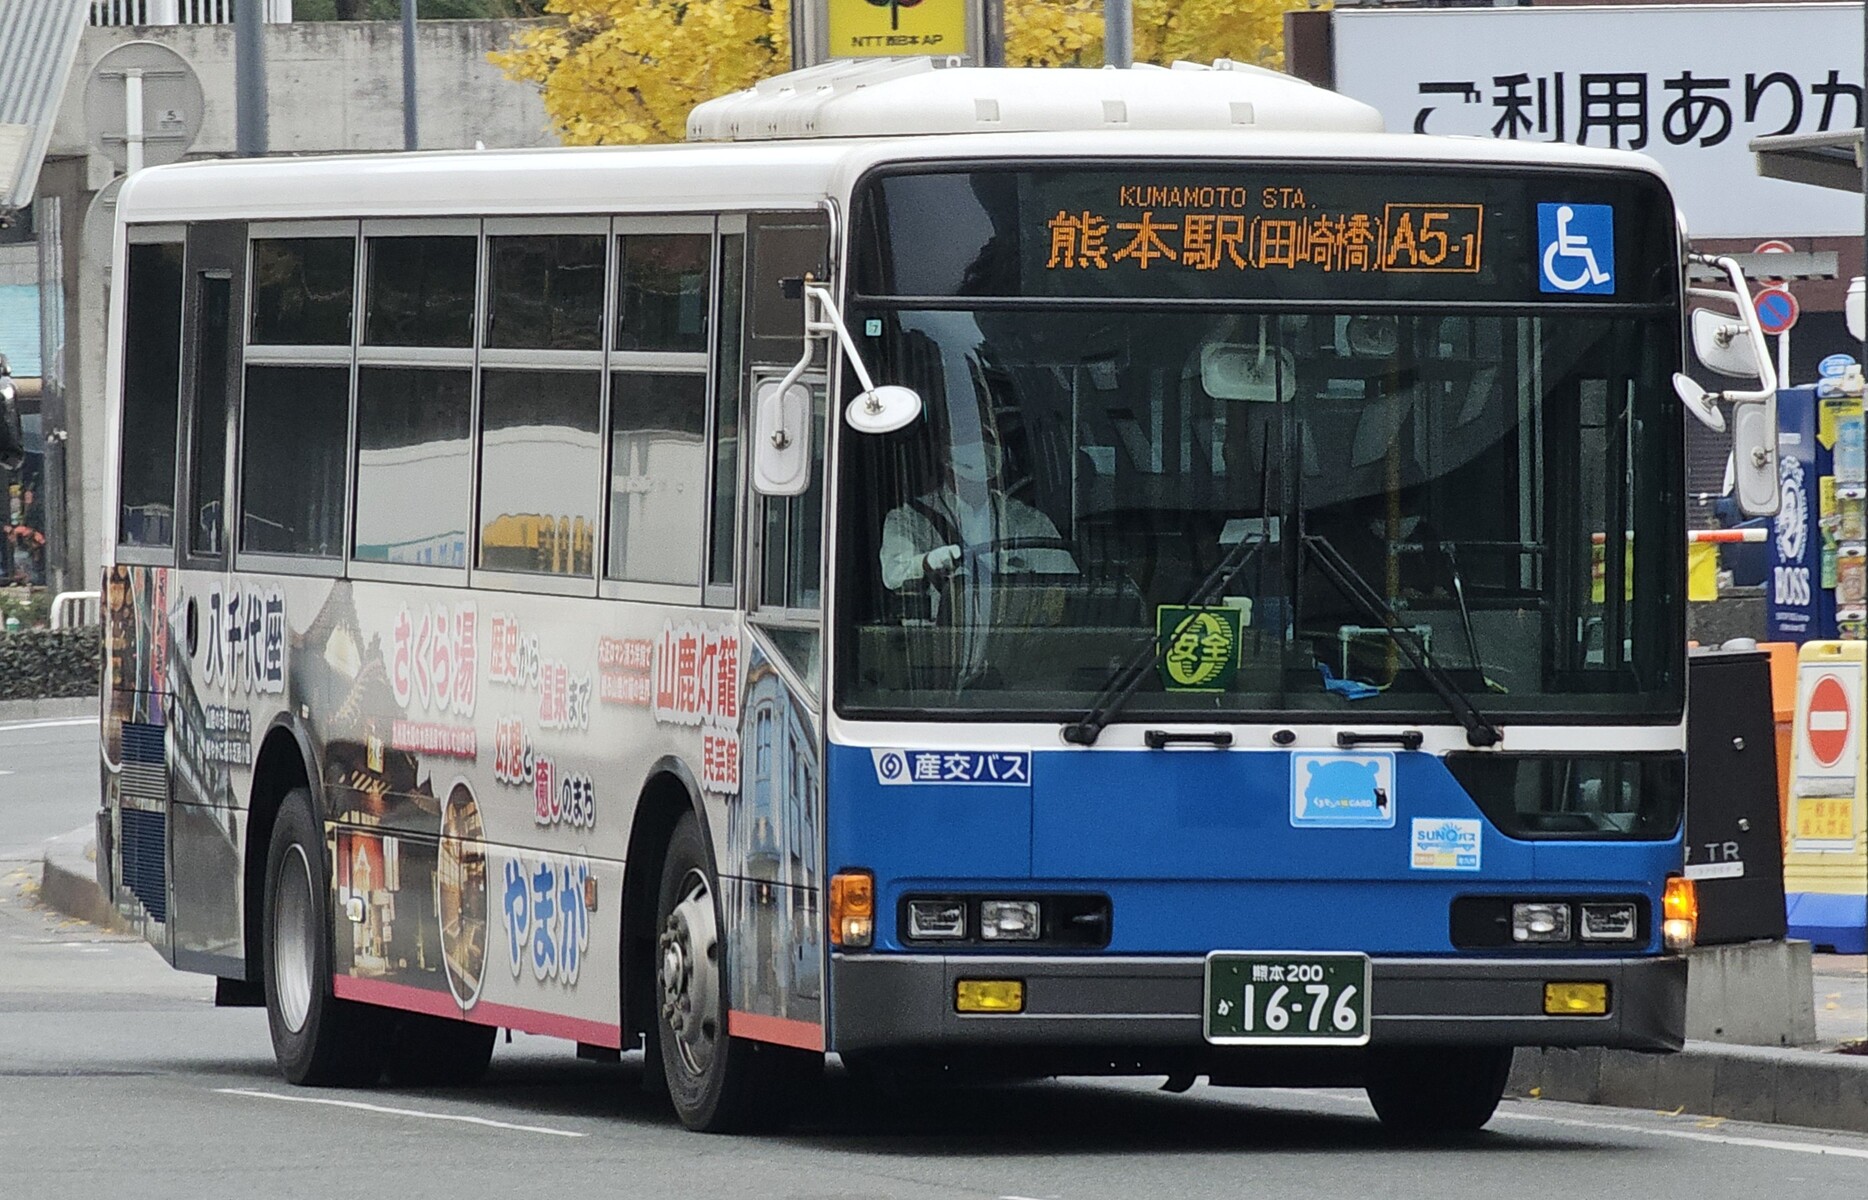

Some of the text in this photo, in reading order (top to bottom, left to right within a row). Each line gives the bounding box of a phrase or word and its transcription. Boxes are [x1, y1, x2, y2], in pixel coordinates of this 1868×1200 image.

[851, 36, 883, 47] NTT
[922, 34, 943, 45] AP
[1120, 185, 1318, 209] KUMAMOTO STA.
[1046, 210, 1384, 273] 熊本駅(田崎橋)
[1387, 212, 1474, 267] A5-1
[206, 592, 284, 684] 八千代座
[394, 611, 476, 706] さくら湯
[489, 617, 540, 681] 歴史から
[1170, 632, 1230, 663] 安全
[540, 664, 590, 724] 温泉まで
[656, 629, 738, 718] 山鹿灯籠
[495, 720, 533, 779] 幻想と
[703, 735, 738, 785] 民芸館
[914, 753, 1026, 781] 産交バス
[535, 761, 595, 821] 癒しのまち
[1705, 841, 1740, 862] TR
[504, 857, 588, 973] やまが
[1252, 964, 1324, 982] 熊本200
[1217, 983, 1357, 1032] か 16-76
